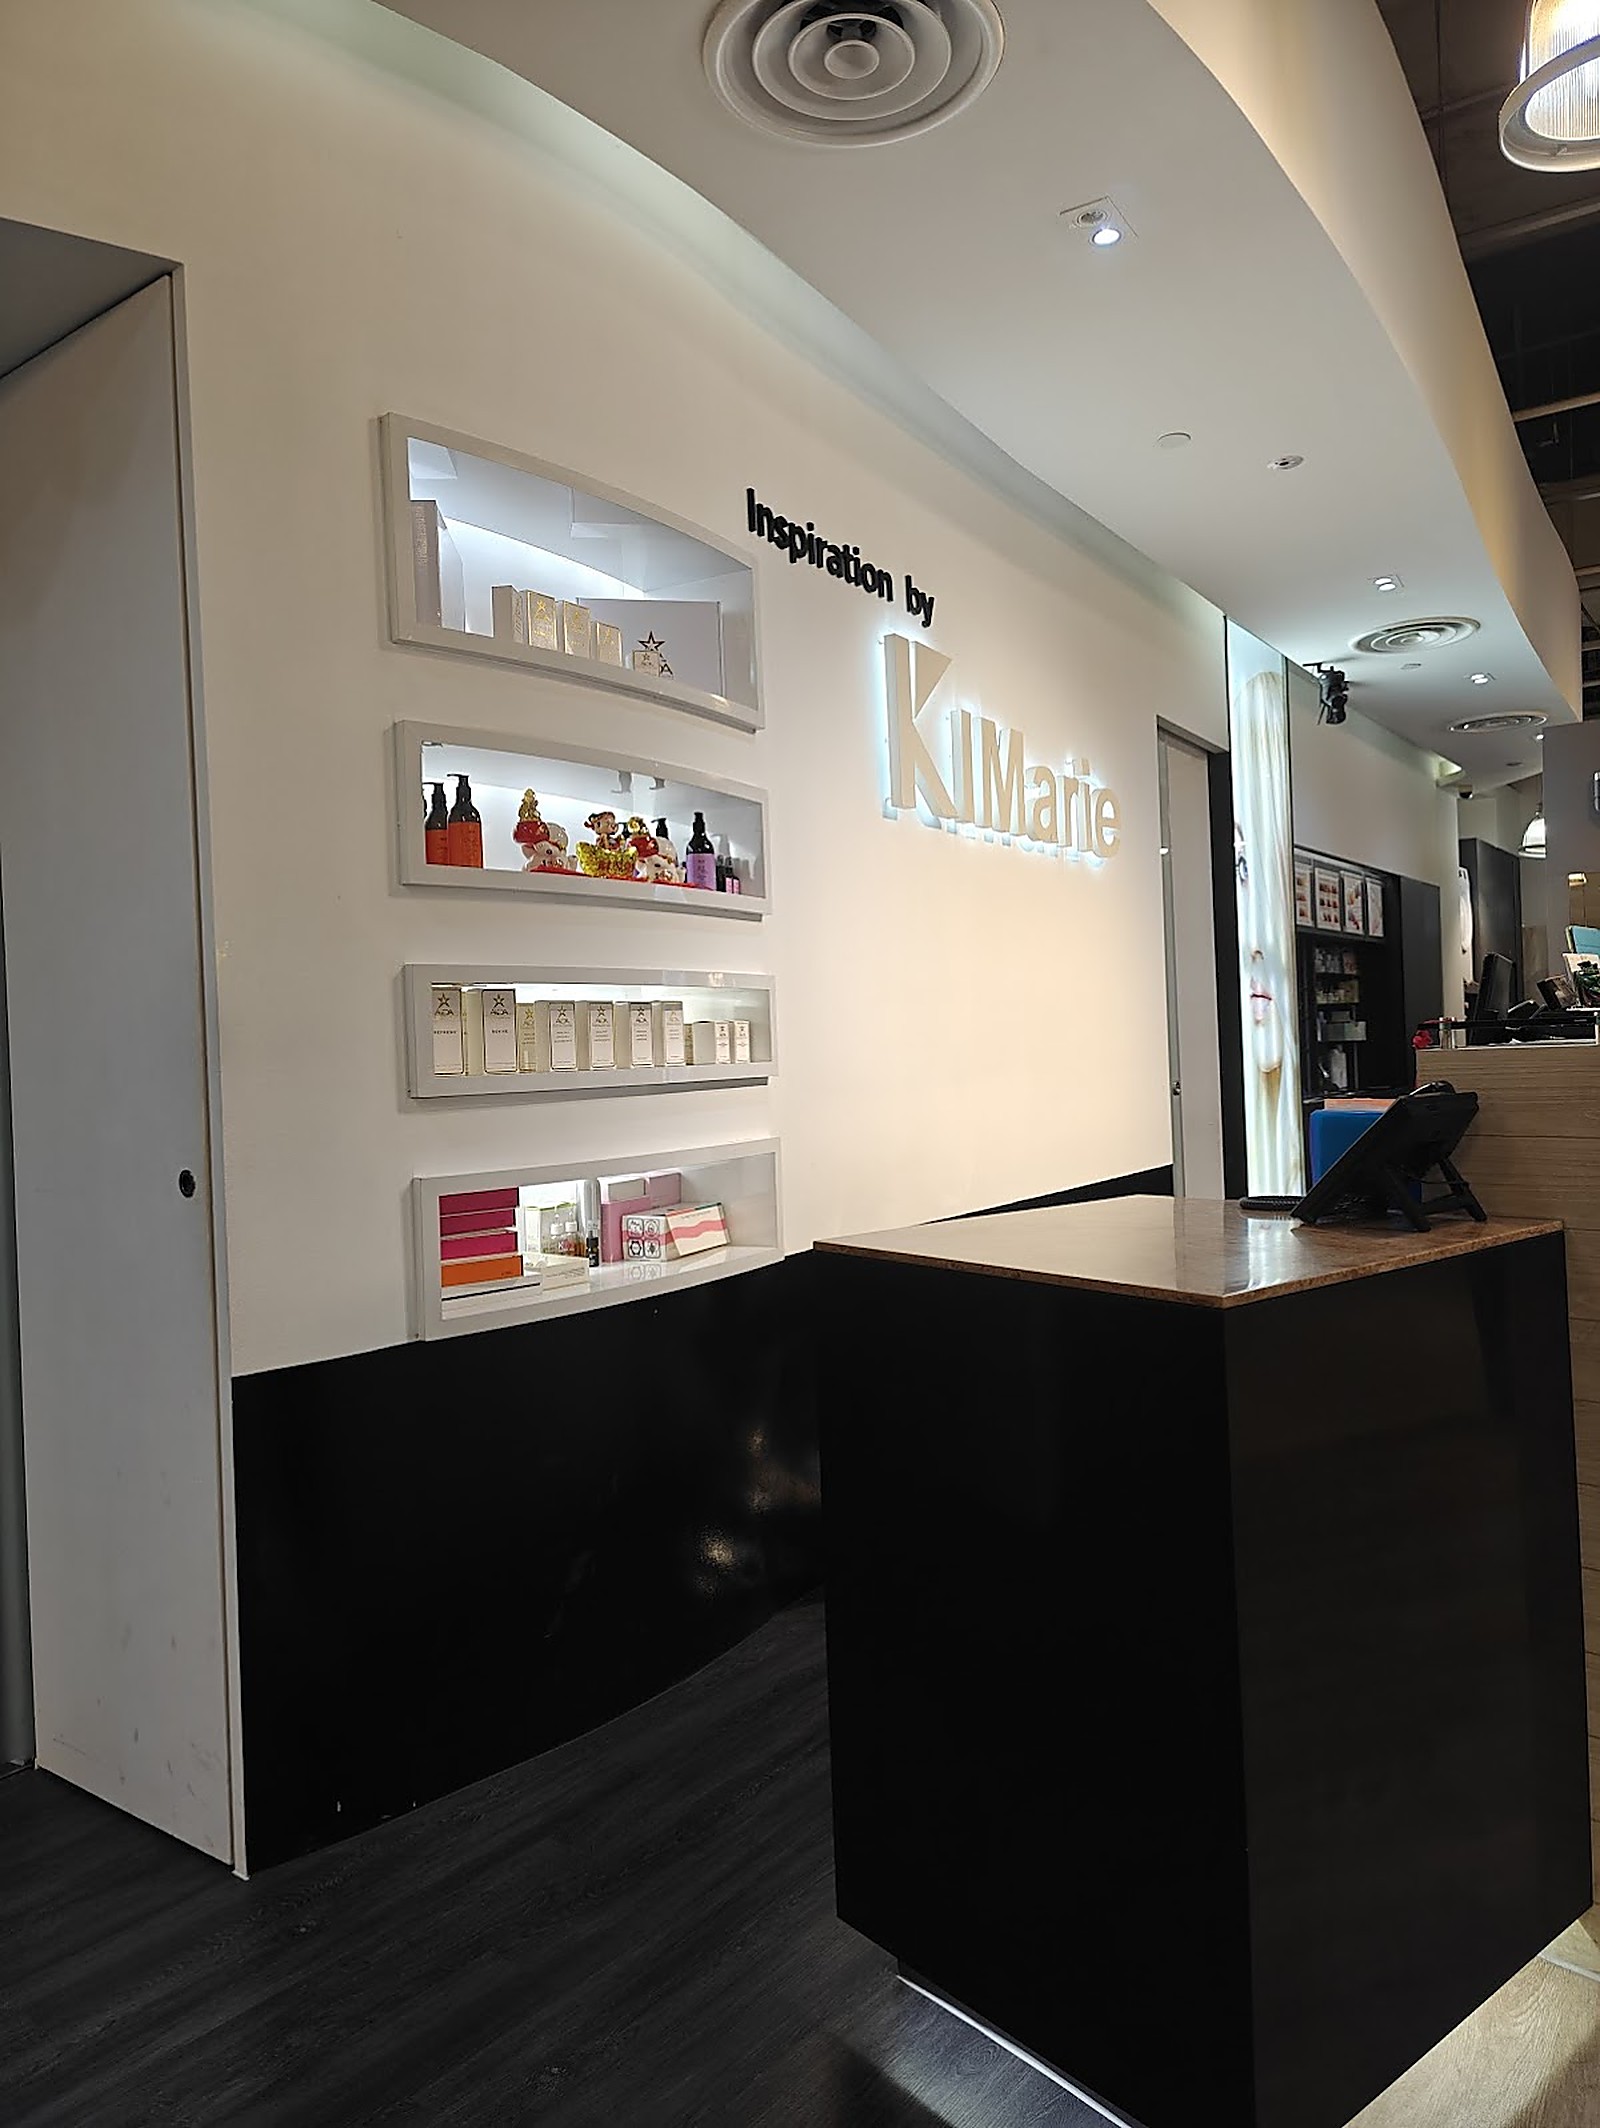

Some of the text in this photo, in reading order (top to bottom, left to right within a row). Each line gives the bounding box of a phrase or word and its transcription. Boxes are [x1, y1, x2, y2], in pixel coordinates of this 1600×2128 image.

[746, 487, 935, 628] Inspiration by
[883, 632, 1122, 859] KIMarie
